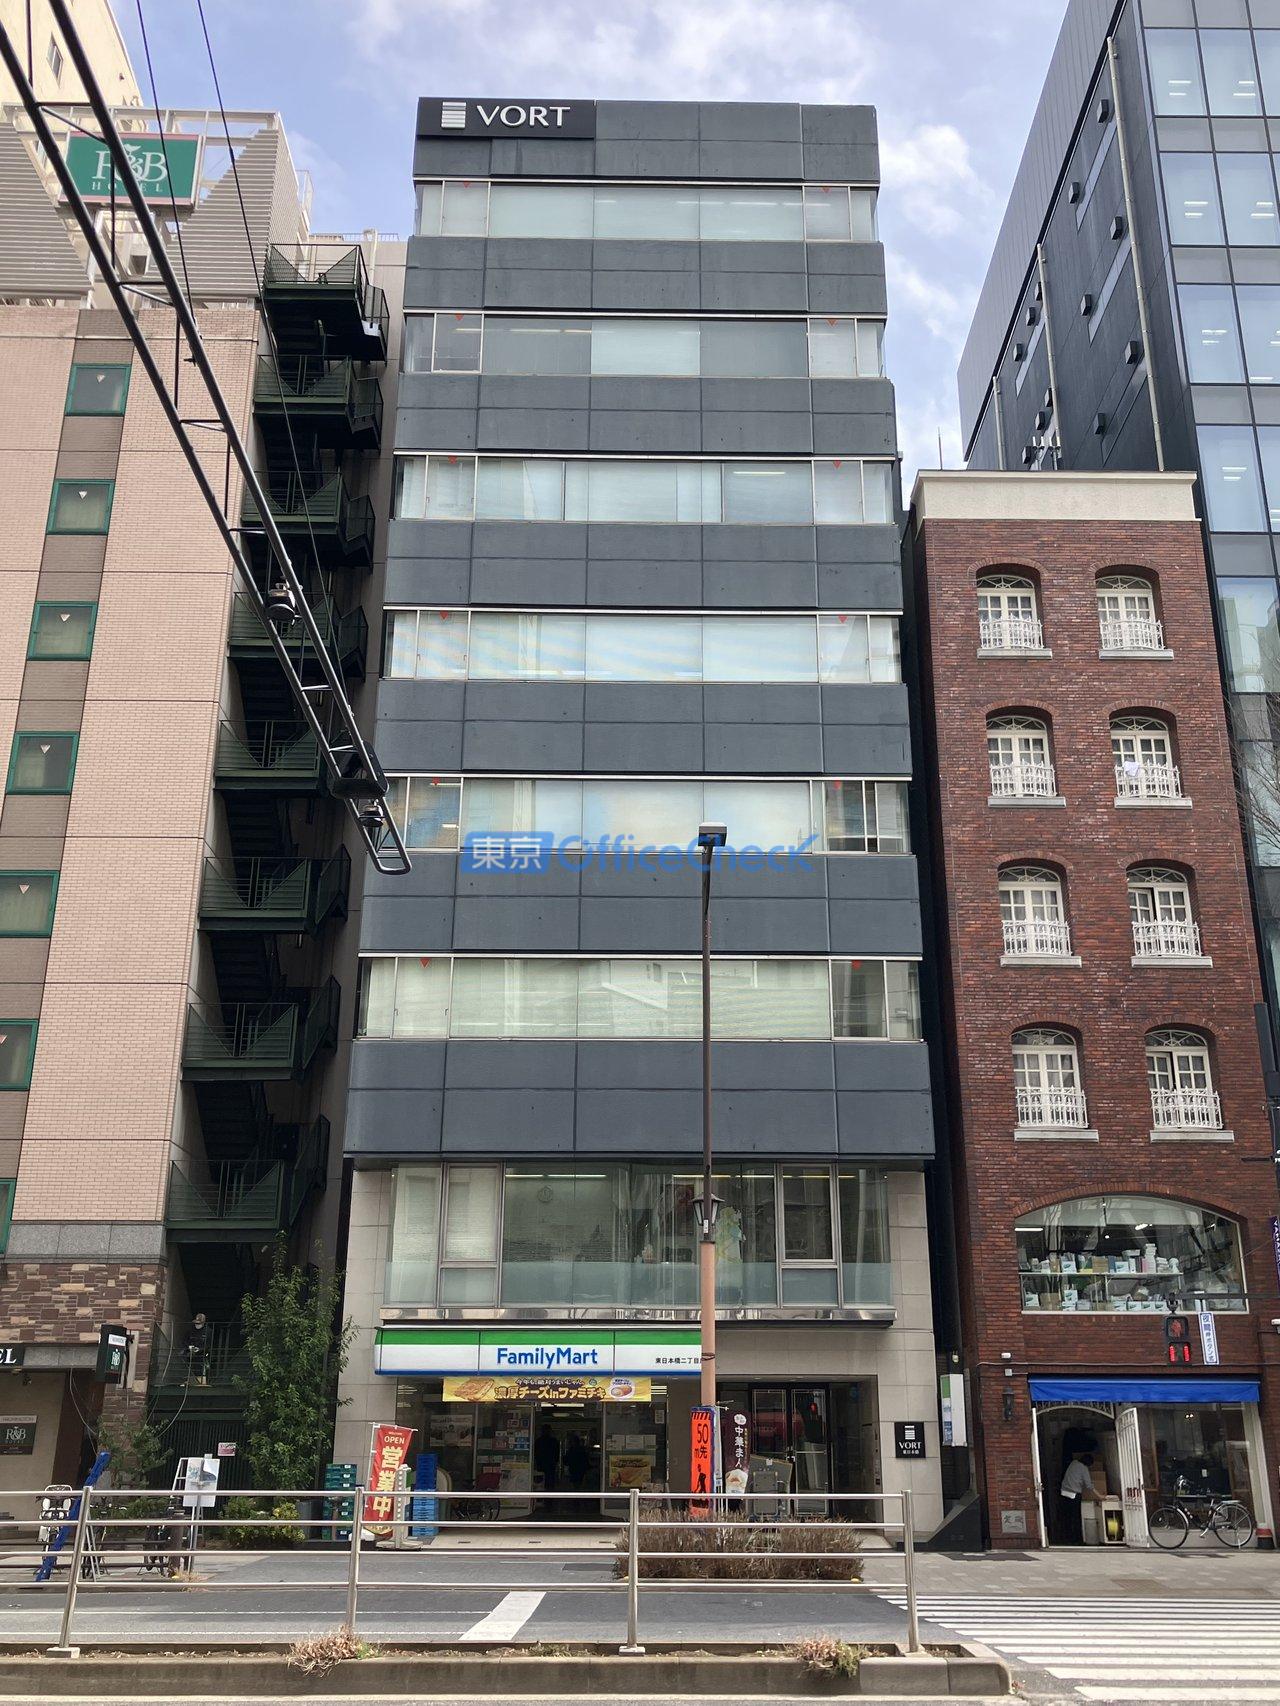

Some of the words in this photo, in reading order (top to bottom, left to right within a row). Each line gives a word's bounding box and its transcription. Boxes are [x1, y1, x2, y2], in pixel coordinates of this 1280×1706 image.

[476, 105, 571, 127] VORT
[91, 181, 163, 193] HOEL
[496, 1347, 598, 1369] FamilyMart
[655, 1357, 702, 1365] 東日本橋二丁目
[494, 1385, 606, 1400] 濃厚チーズinファミチキ
[384, 1435, 405, 1444] OPEN
[696, 1423, 709, 1444] 50
[898, 1441, 922, 1450] VORT
[372, 1445, 404, 1518] 営業中
